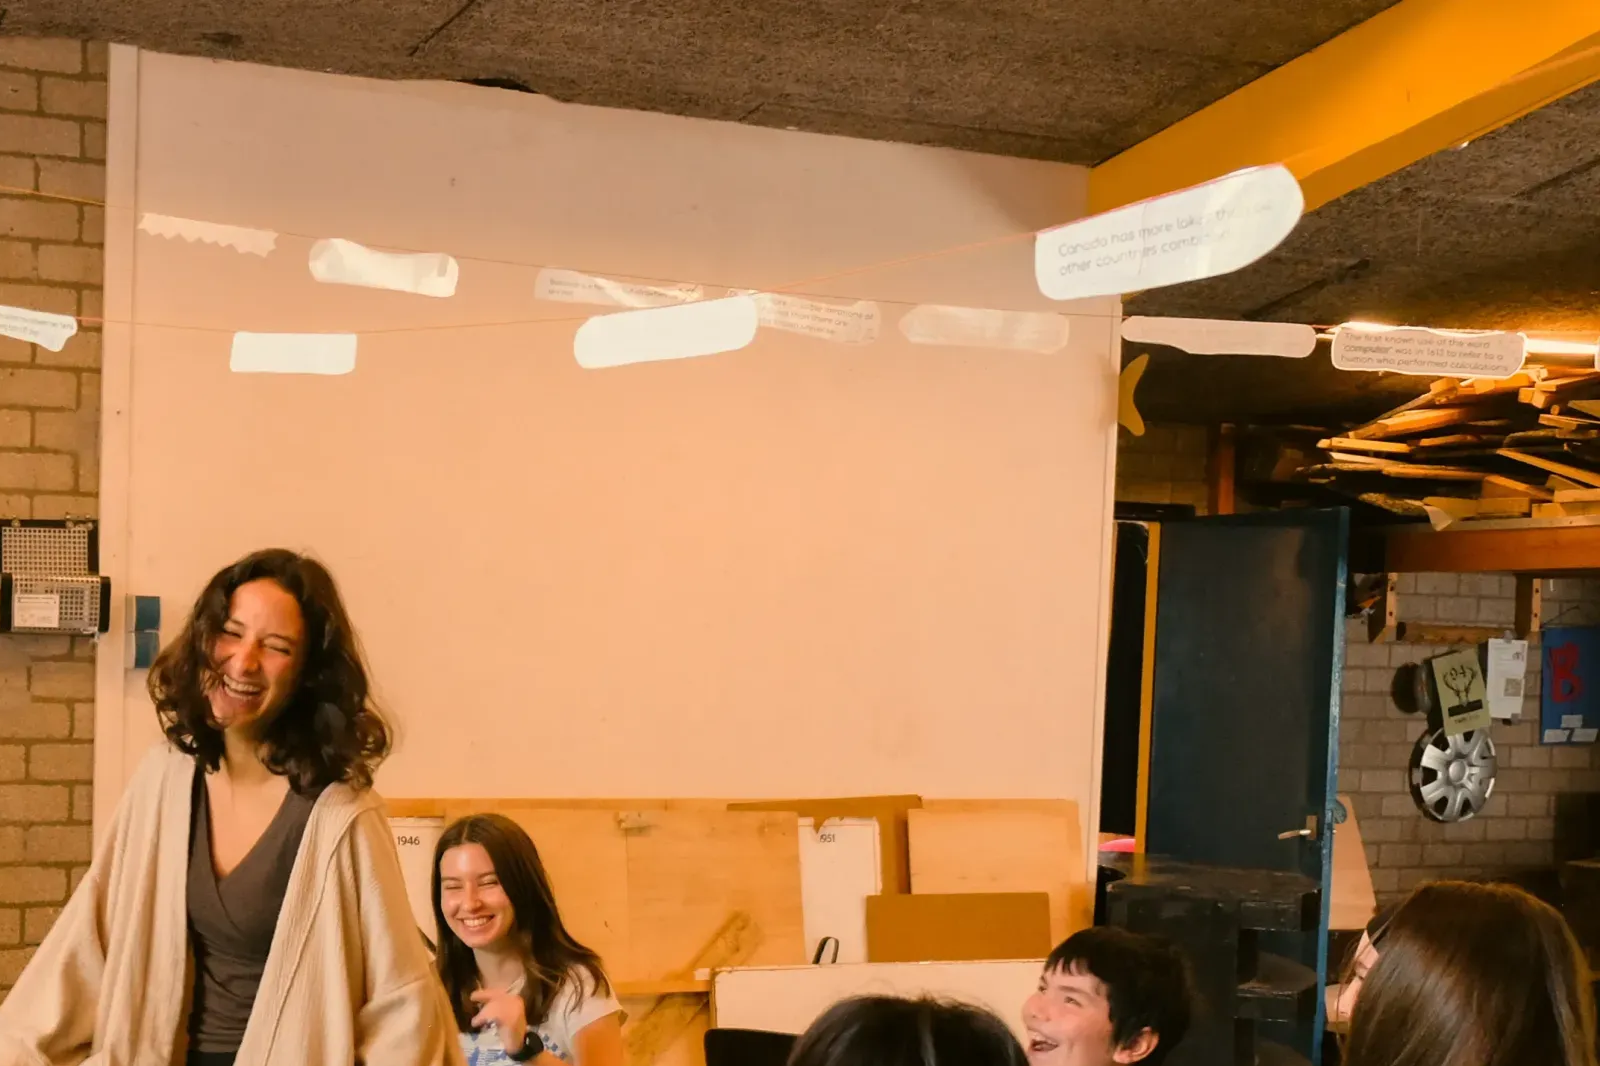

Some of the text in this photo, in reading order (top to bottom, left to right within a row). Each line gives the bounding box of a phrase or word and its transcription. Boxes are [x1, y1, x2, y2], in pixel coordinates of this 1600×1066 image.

[1058, 236, 1108, 257] Canada
[1111, 230, 1135, 245] has
[1138, 223, 1173, 238] more
[1177, 215, 1206, 231] lak
[1059, 258, 1092, 276] other
[397, 835, 421, 846] 1946
